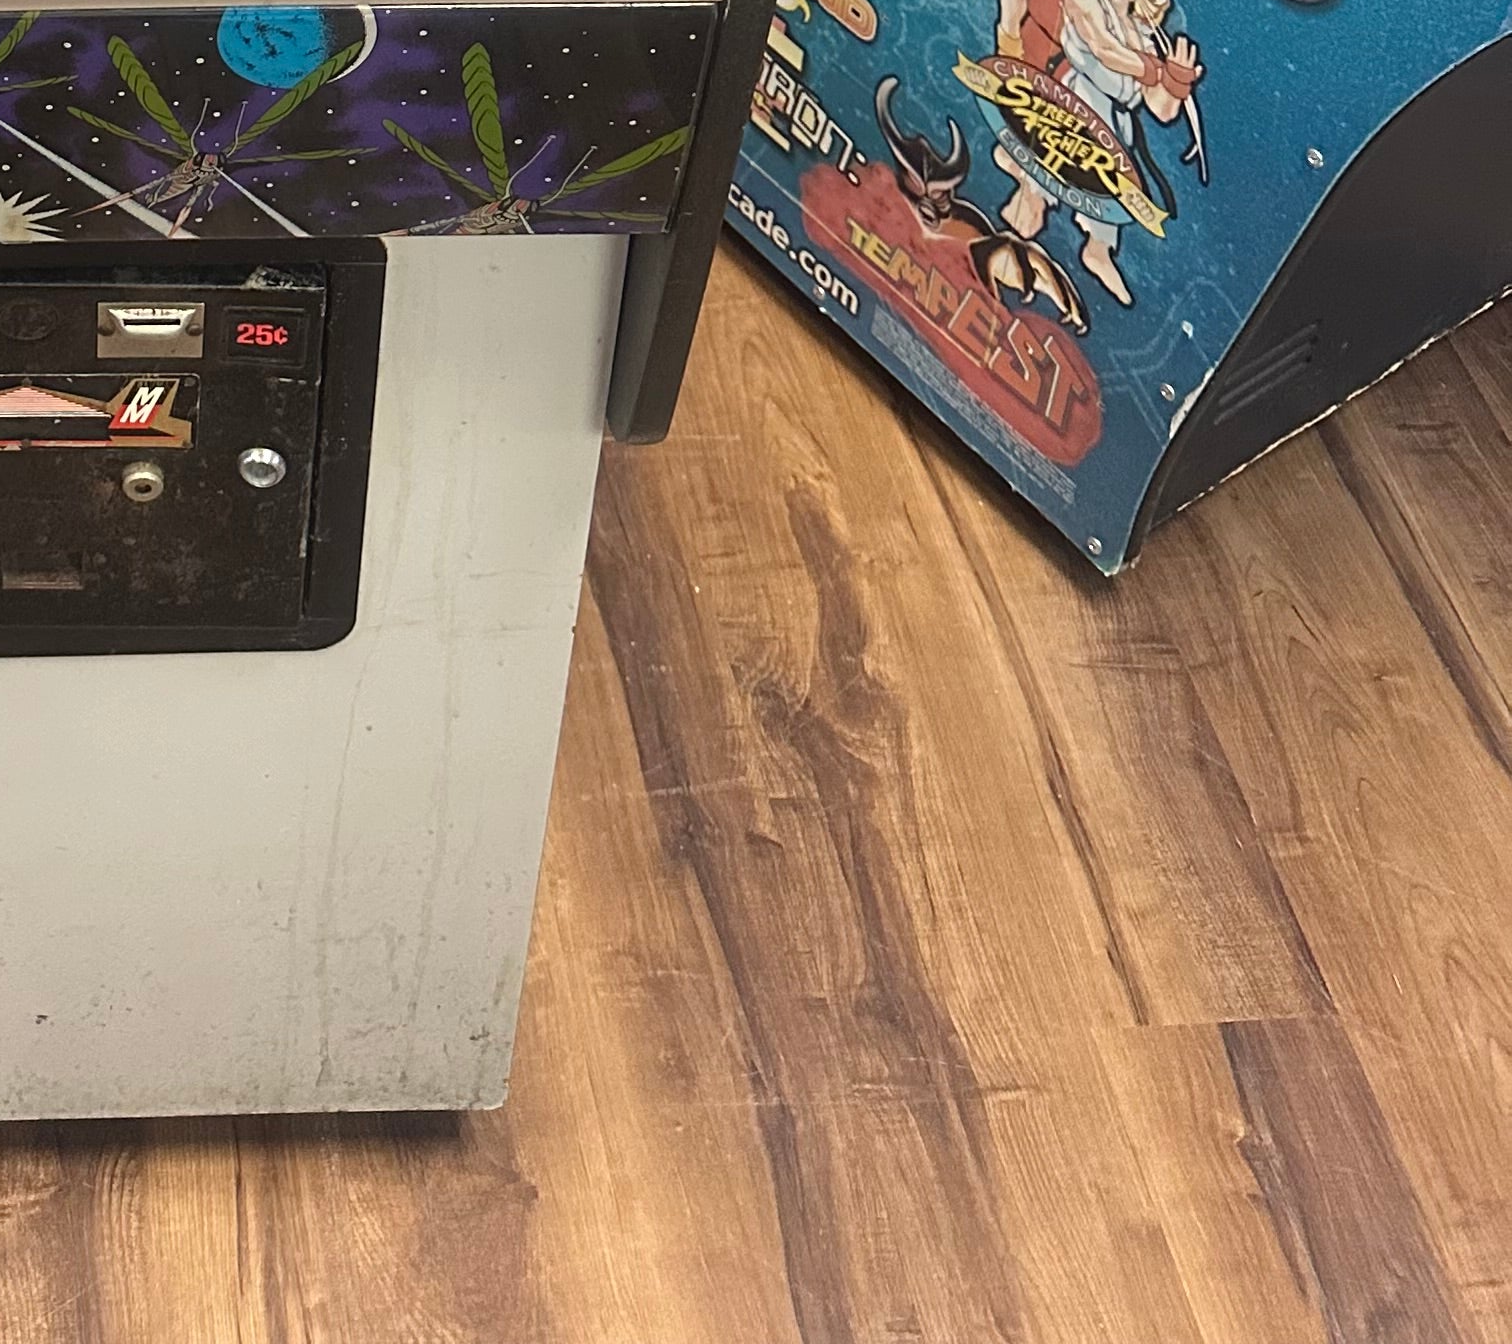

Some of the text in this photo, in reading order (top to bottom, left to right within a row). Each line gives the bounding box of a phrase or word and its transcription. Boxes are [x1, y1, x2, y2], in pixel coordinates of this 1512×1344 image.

[992, 59, 1132, 173] CHAMPION
[994, 76, 1089, 136] STREET
[998, 127, 1104, 218] EDITION
[1013, 107, 1123, 197] FIGHTER
[235, 321, 289, 347] 25¢
[847, 216, 1088, 434] TEMPEST
